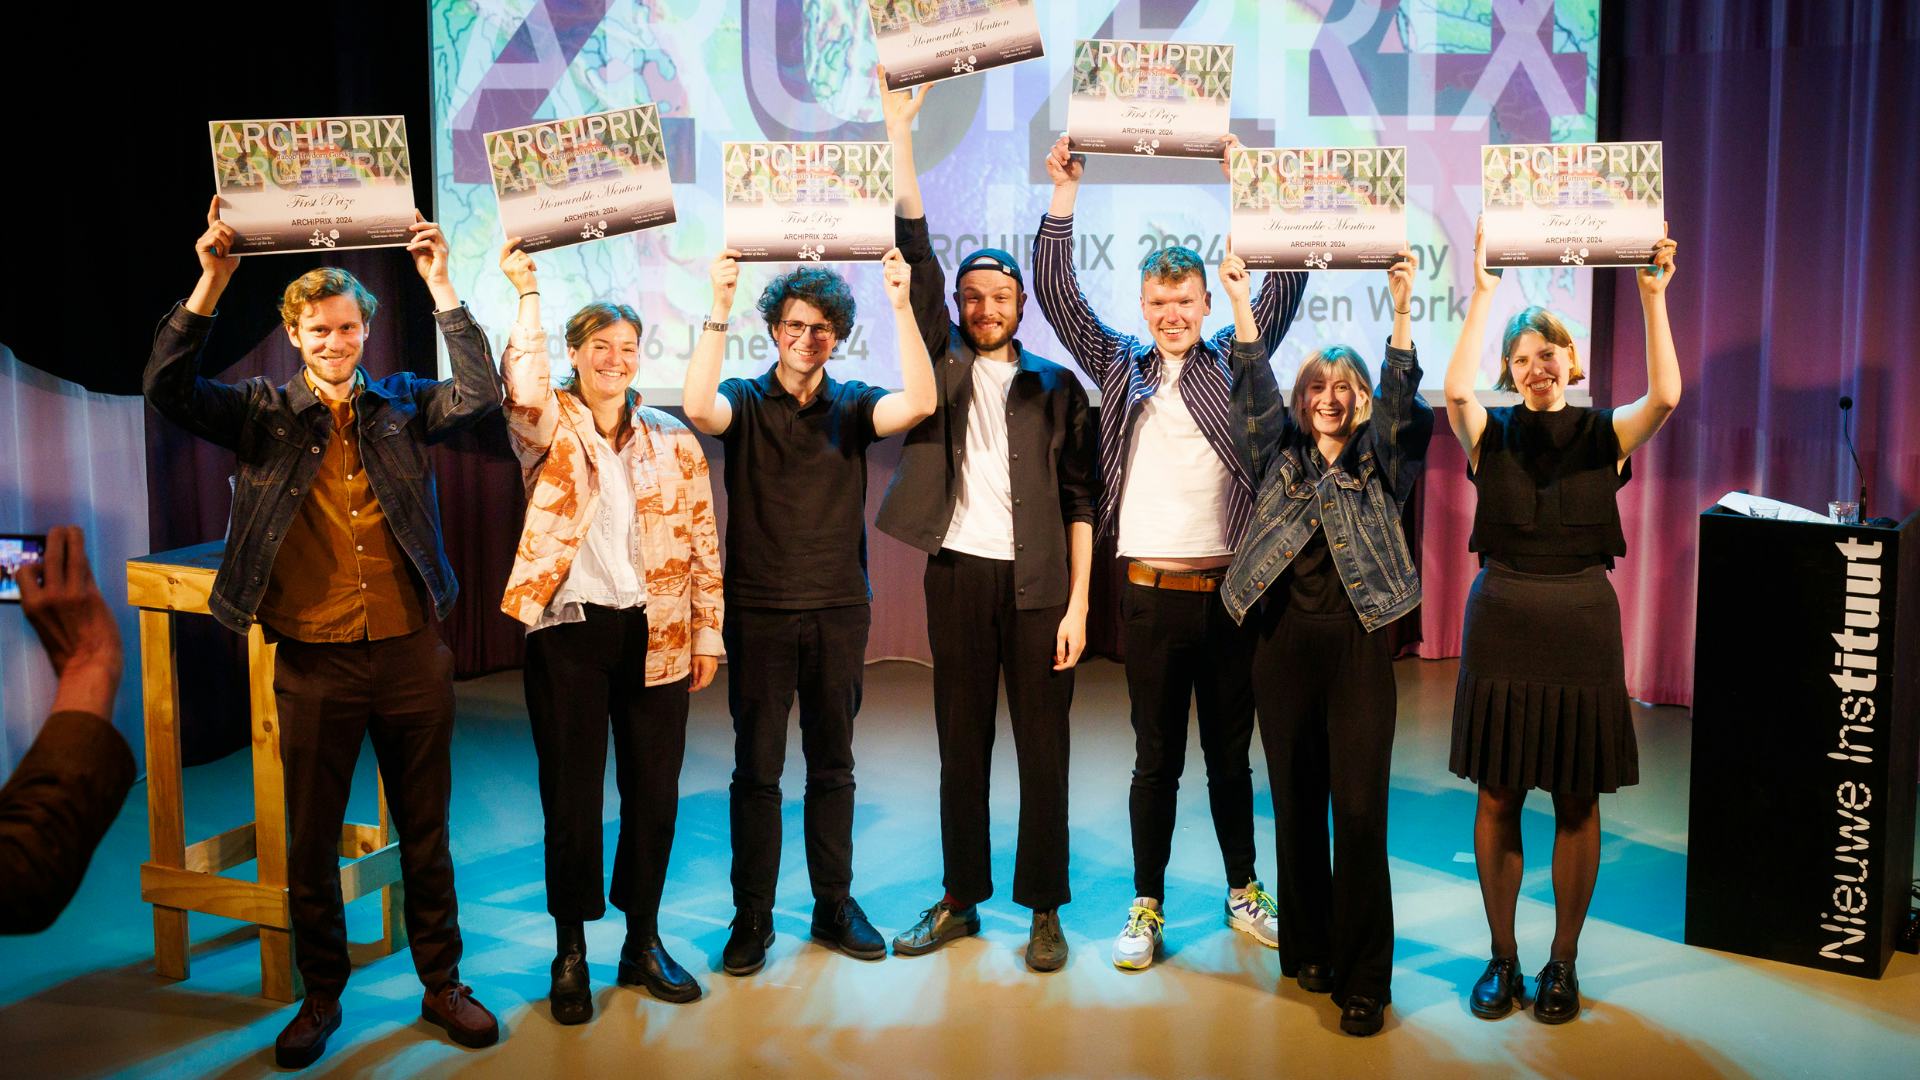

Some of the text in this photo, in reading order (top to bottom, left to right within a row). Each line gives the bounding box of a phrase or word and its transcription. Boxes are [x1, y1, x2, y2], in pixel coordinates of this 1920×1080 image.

[907, 17, 1010, 48] Honourable Mention
[935, 42, 987, 59] ARCHIPRIX 2024
[1076, 42, 1231, 72] ARCHIPRIX
[1121, 106, 1179, 124] First Prize
[218, 119, 406, 154] ARCHIPRIX
[492, 106, 660, 164] ARCHIPRIX
[726, 144, 893, 172] ARCHIPRIX
[1234, 150, 1404, 178] ARCHIPRIX
[1486, 145, 1660, 174] ARCHIPRIX
[286, 191, 356, 210] First Prize
[533, 183, 643, 212] Honourable Mention
[291, 216, 353, 226] ARCHIPRIX 2024
[564, 210, 599, 223] ARCHIPRIX
[602, 206, 618, 215] 2024
[781, 209, 843, 226] First Prize
[1264, 217, 1376, 231] Honourable Mention
[1542, 213, 1607, 231] First Prize
[929, 233, 1115, 270] RCIPIX
[676, 325, 769, 360] Jne
[1818, 536, 1884, 963] Nieuwe Instituut
